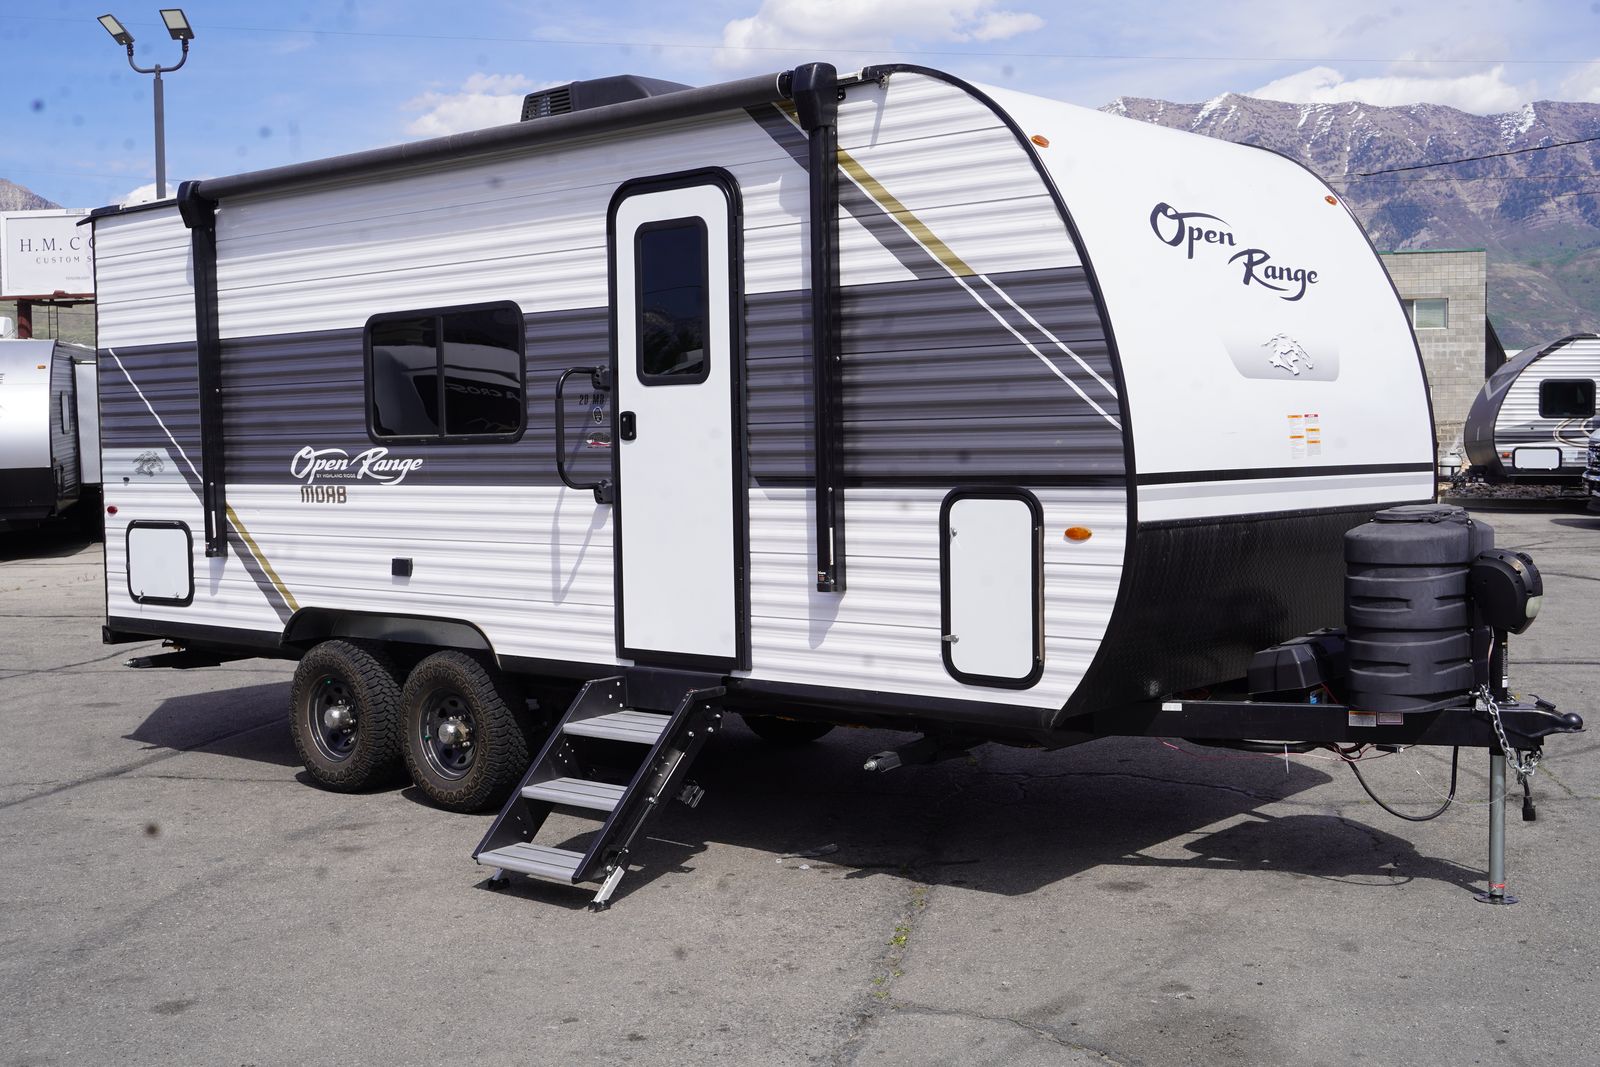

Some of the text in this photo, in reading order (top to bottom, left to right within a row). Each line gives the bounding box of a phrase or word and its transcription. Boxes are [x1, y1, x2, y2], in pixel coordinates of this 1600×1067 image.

[1150, 202, 1237, 259] Open
[36, 256, 80, 264] CUSTOM
[1227, 248, 1319, 301] Range
[290, 446, 423, 485] Open Range
[301, 485, 347, 503] MOAB
